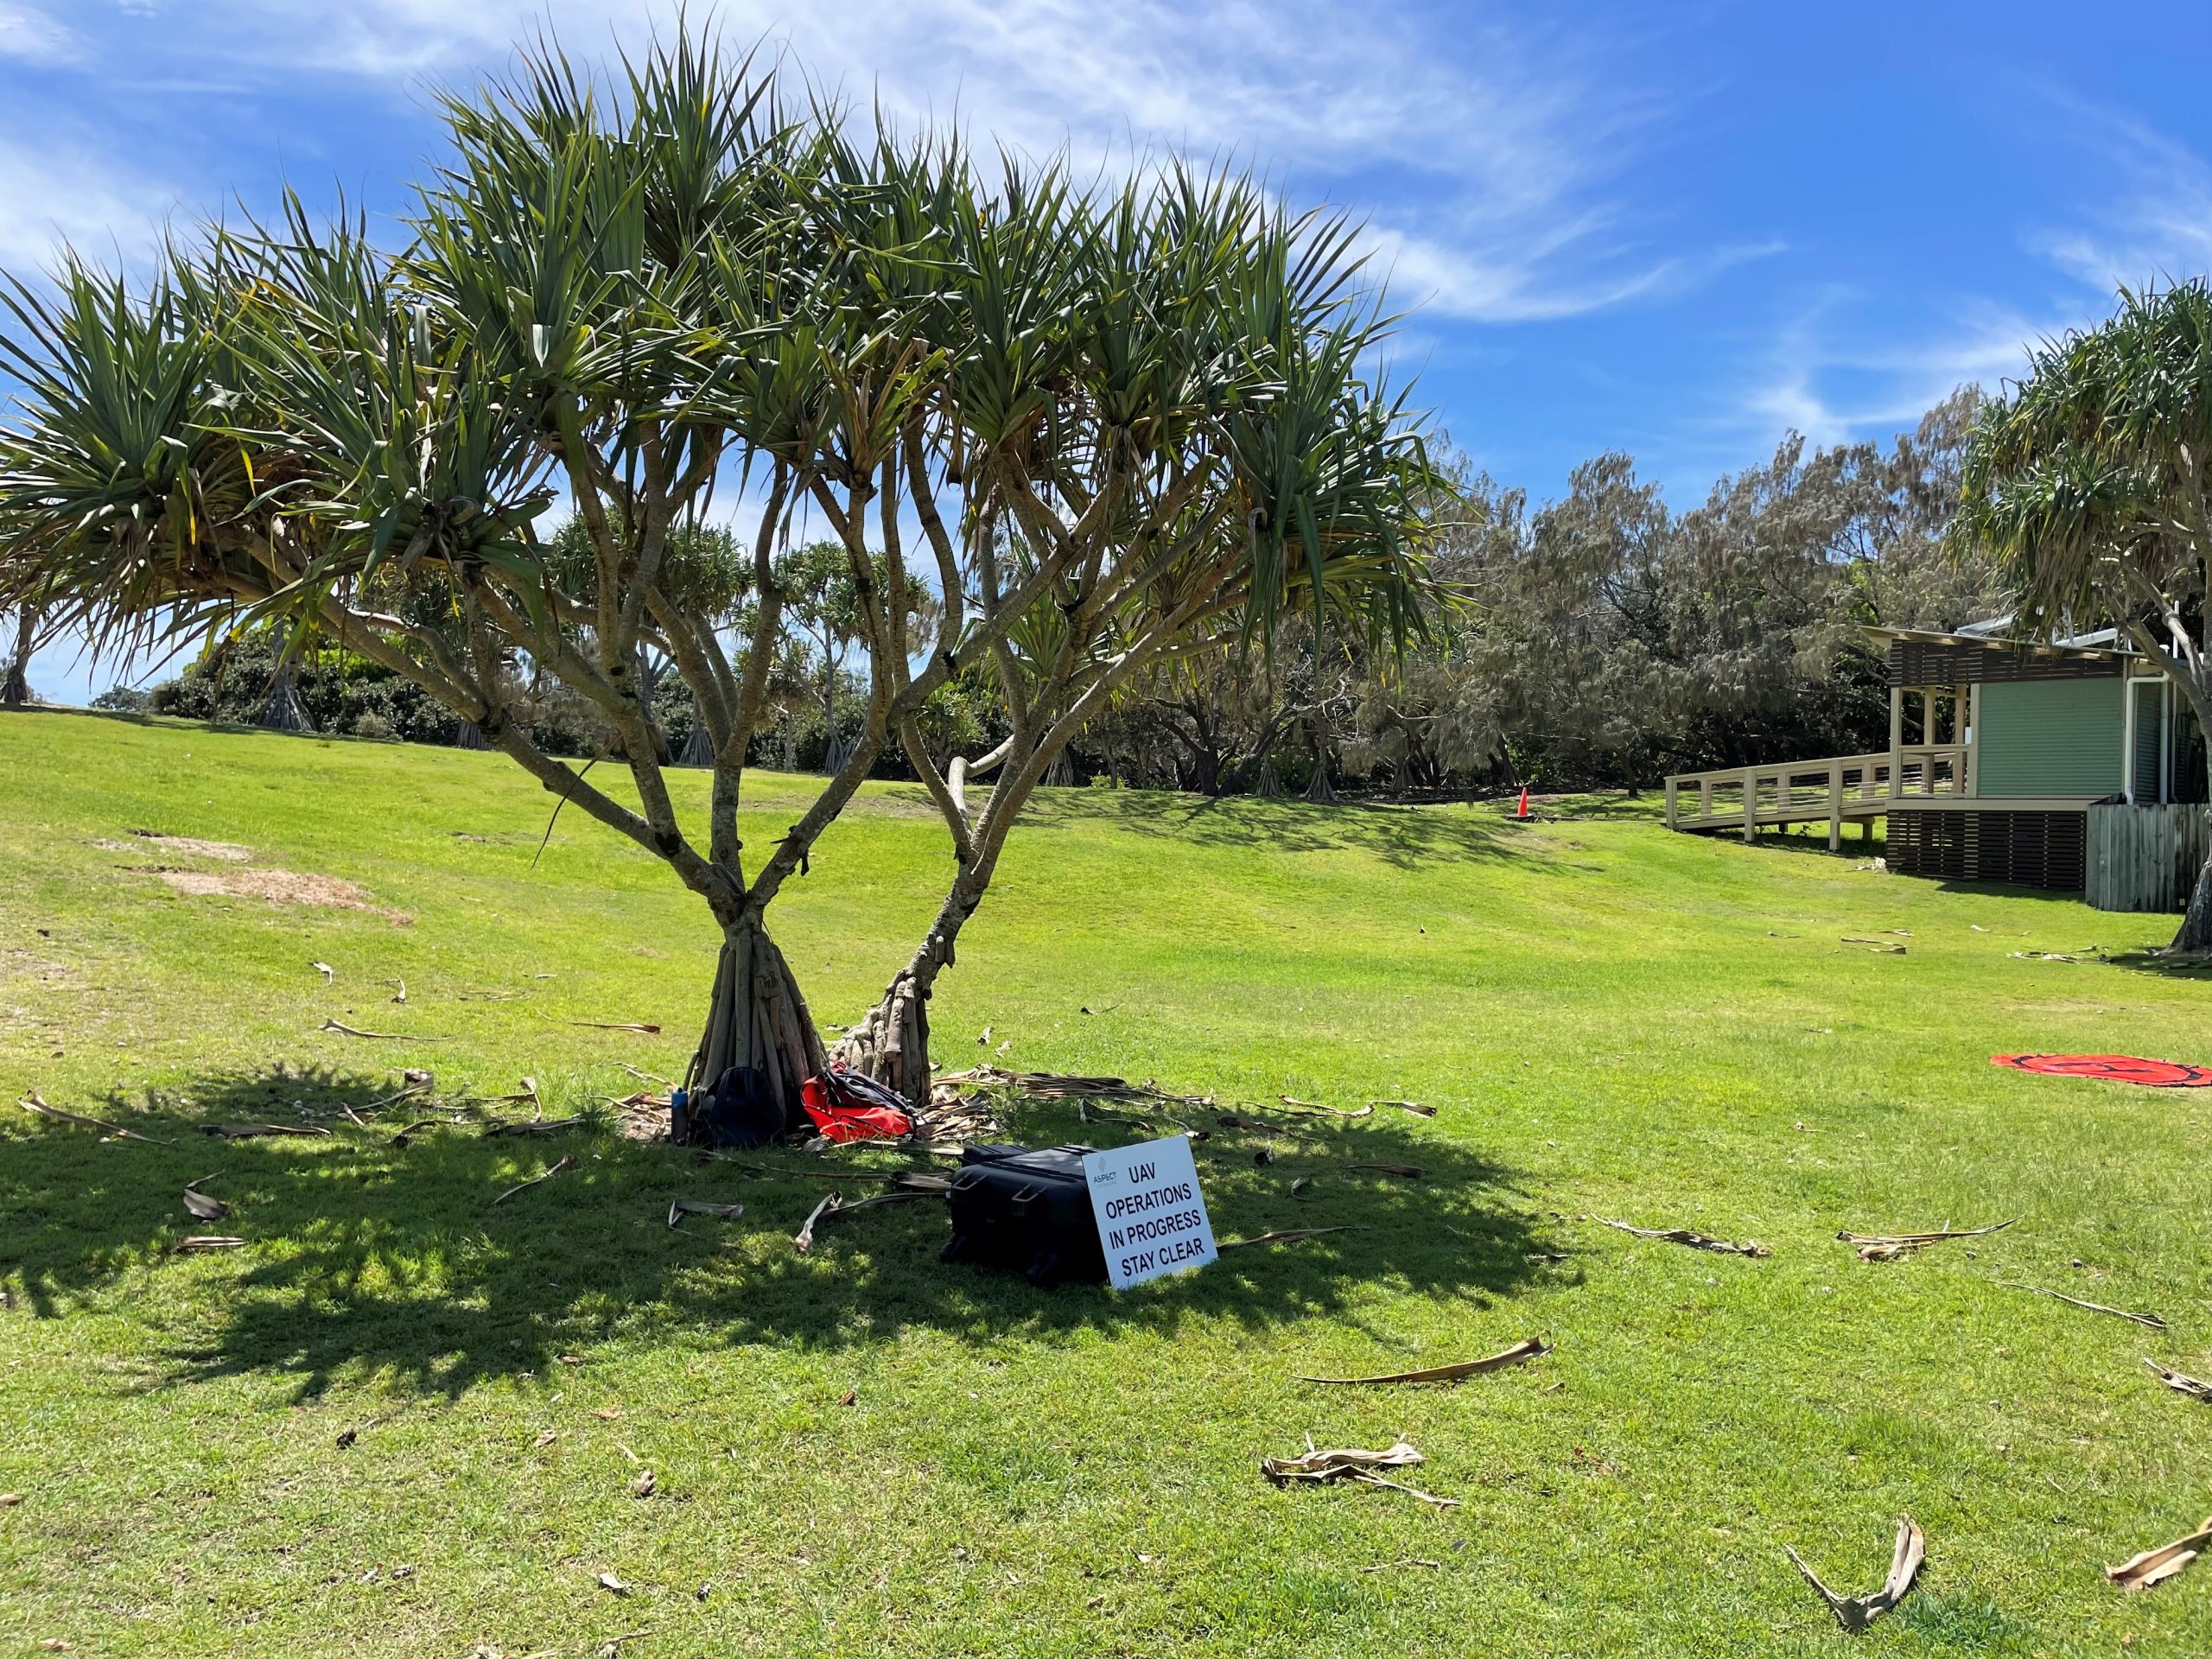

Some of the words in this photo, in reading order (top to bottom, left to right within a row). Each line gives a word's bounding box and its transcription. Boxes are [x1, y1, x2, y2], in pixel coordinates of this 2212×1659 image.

[1093, 1172, 1116, 1184] ASPECT
[1128, 1162, 1155, 1184] UAV
[1106, 1183, 1192, 1219] OPERATIONS
[1109, 1230, 1124, 1249] IN
[1127, 1210, 1201, 1244] PROGRESS
[1122, 1251, 1154, 1277] STAY
[1159, 1237, 1205, 1266] CLEAR
